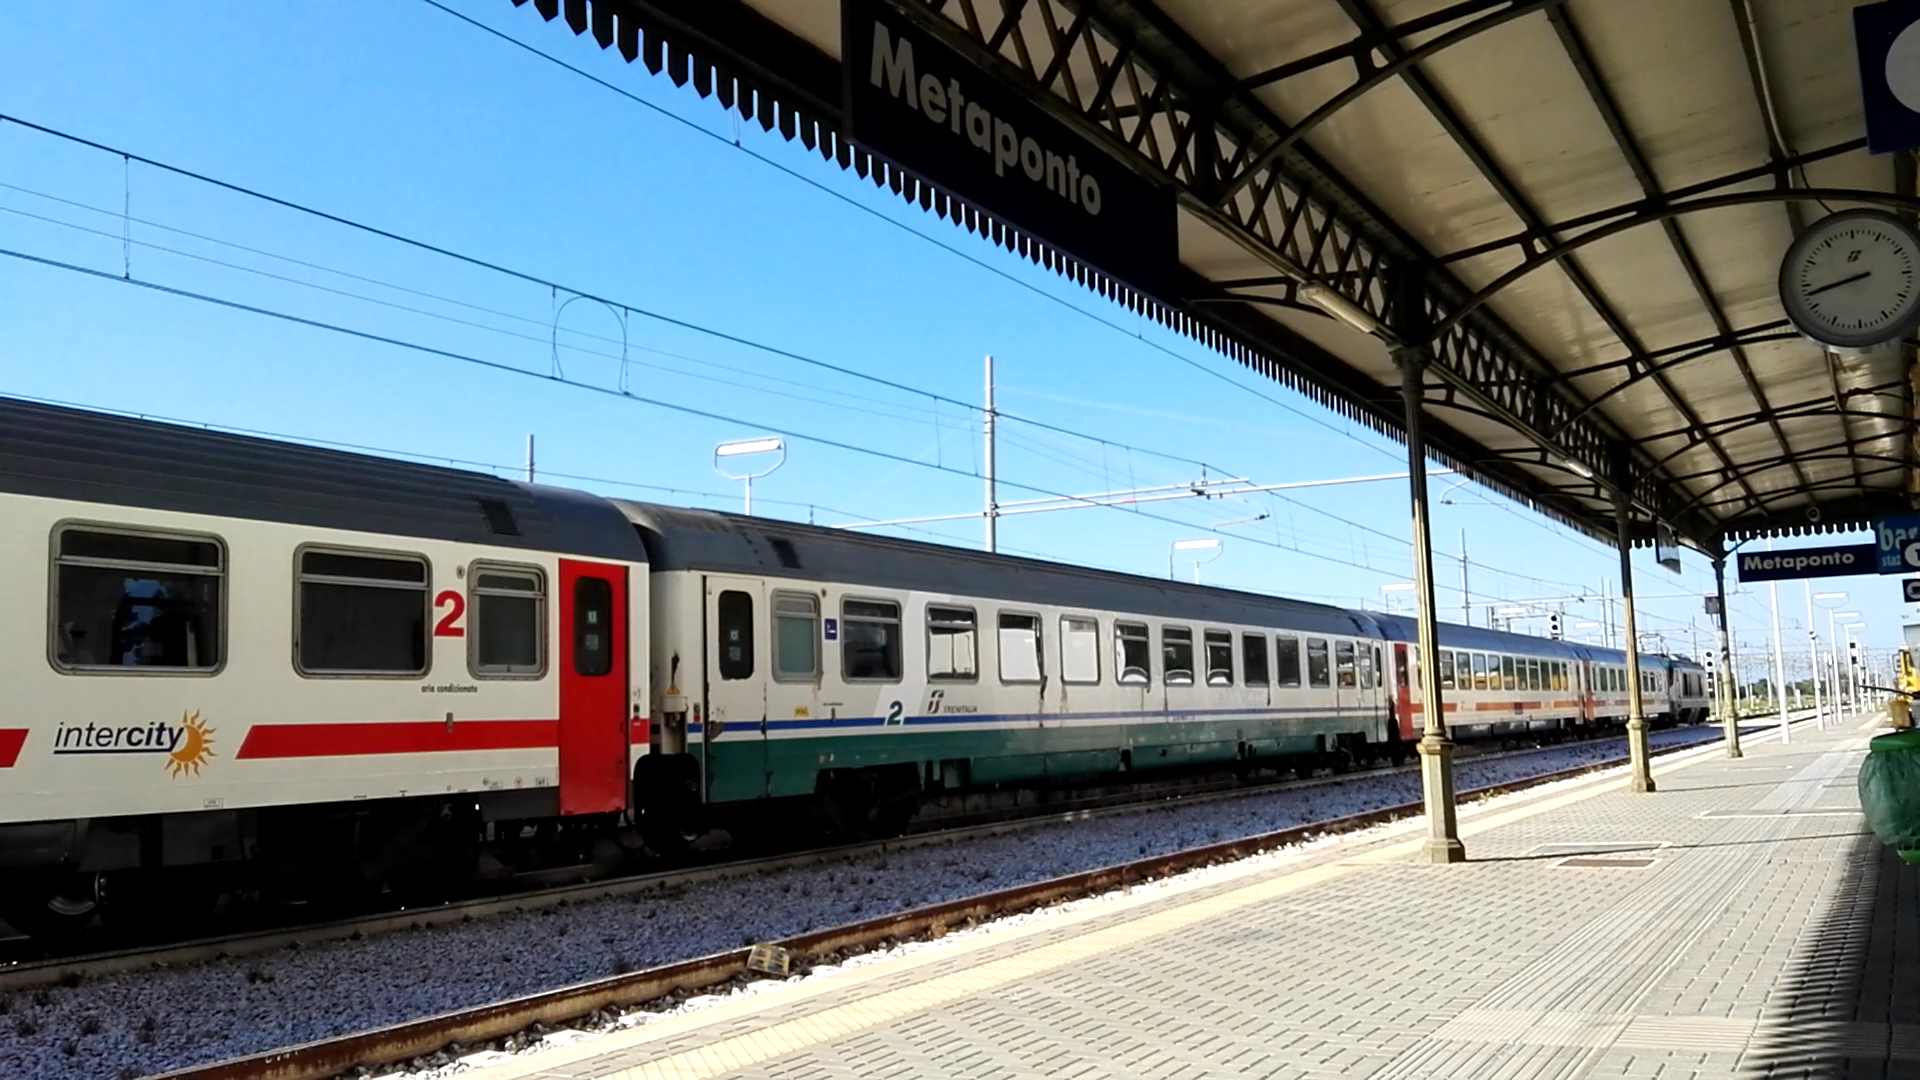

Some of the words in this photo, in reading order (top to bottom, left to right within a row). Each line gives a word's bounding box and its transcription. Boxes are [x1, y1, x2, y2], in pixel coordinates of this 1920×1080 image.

[870, 20, 1101, 216] Metaponto
[1744, 552, 1855, 571] Metaponto
[434, 590, 465, 637] 2
[886, 701, 904, 726] 2
[943, 705, 978, 713] TRENITALIA
[54, 721, 185, 751] intercity
